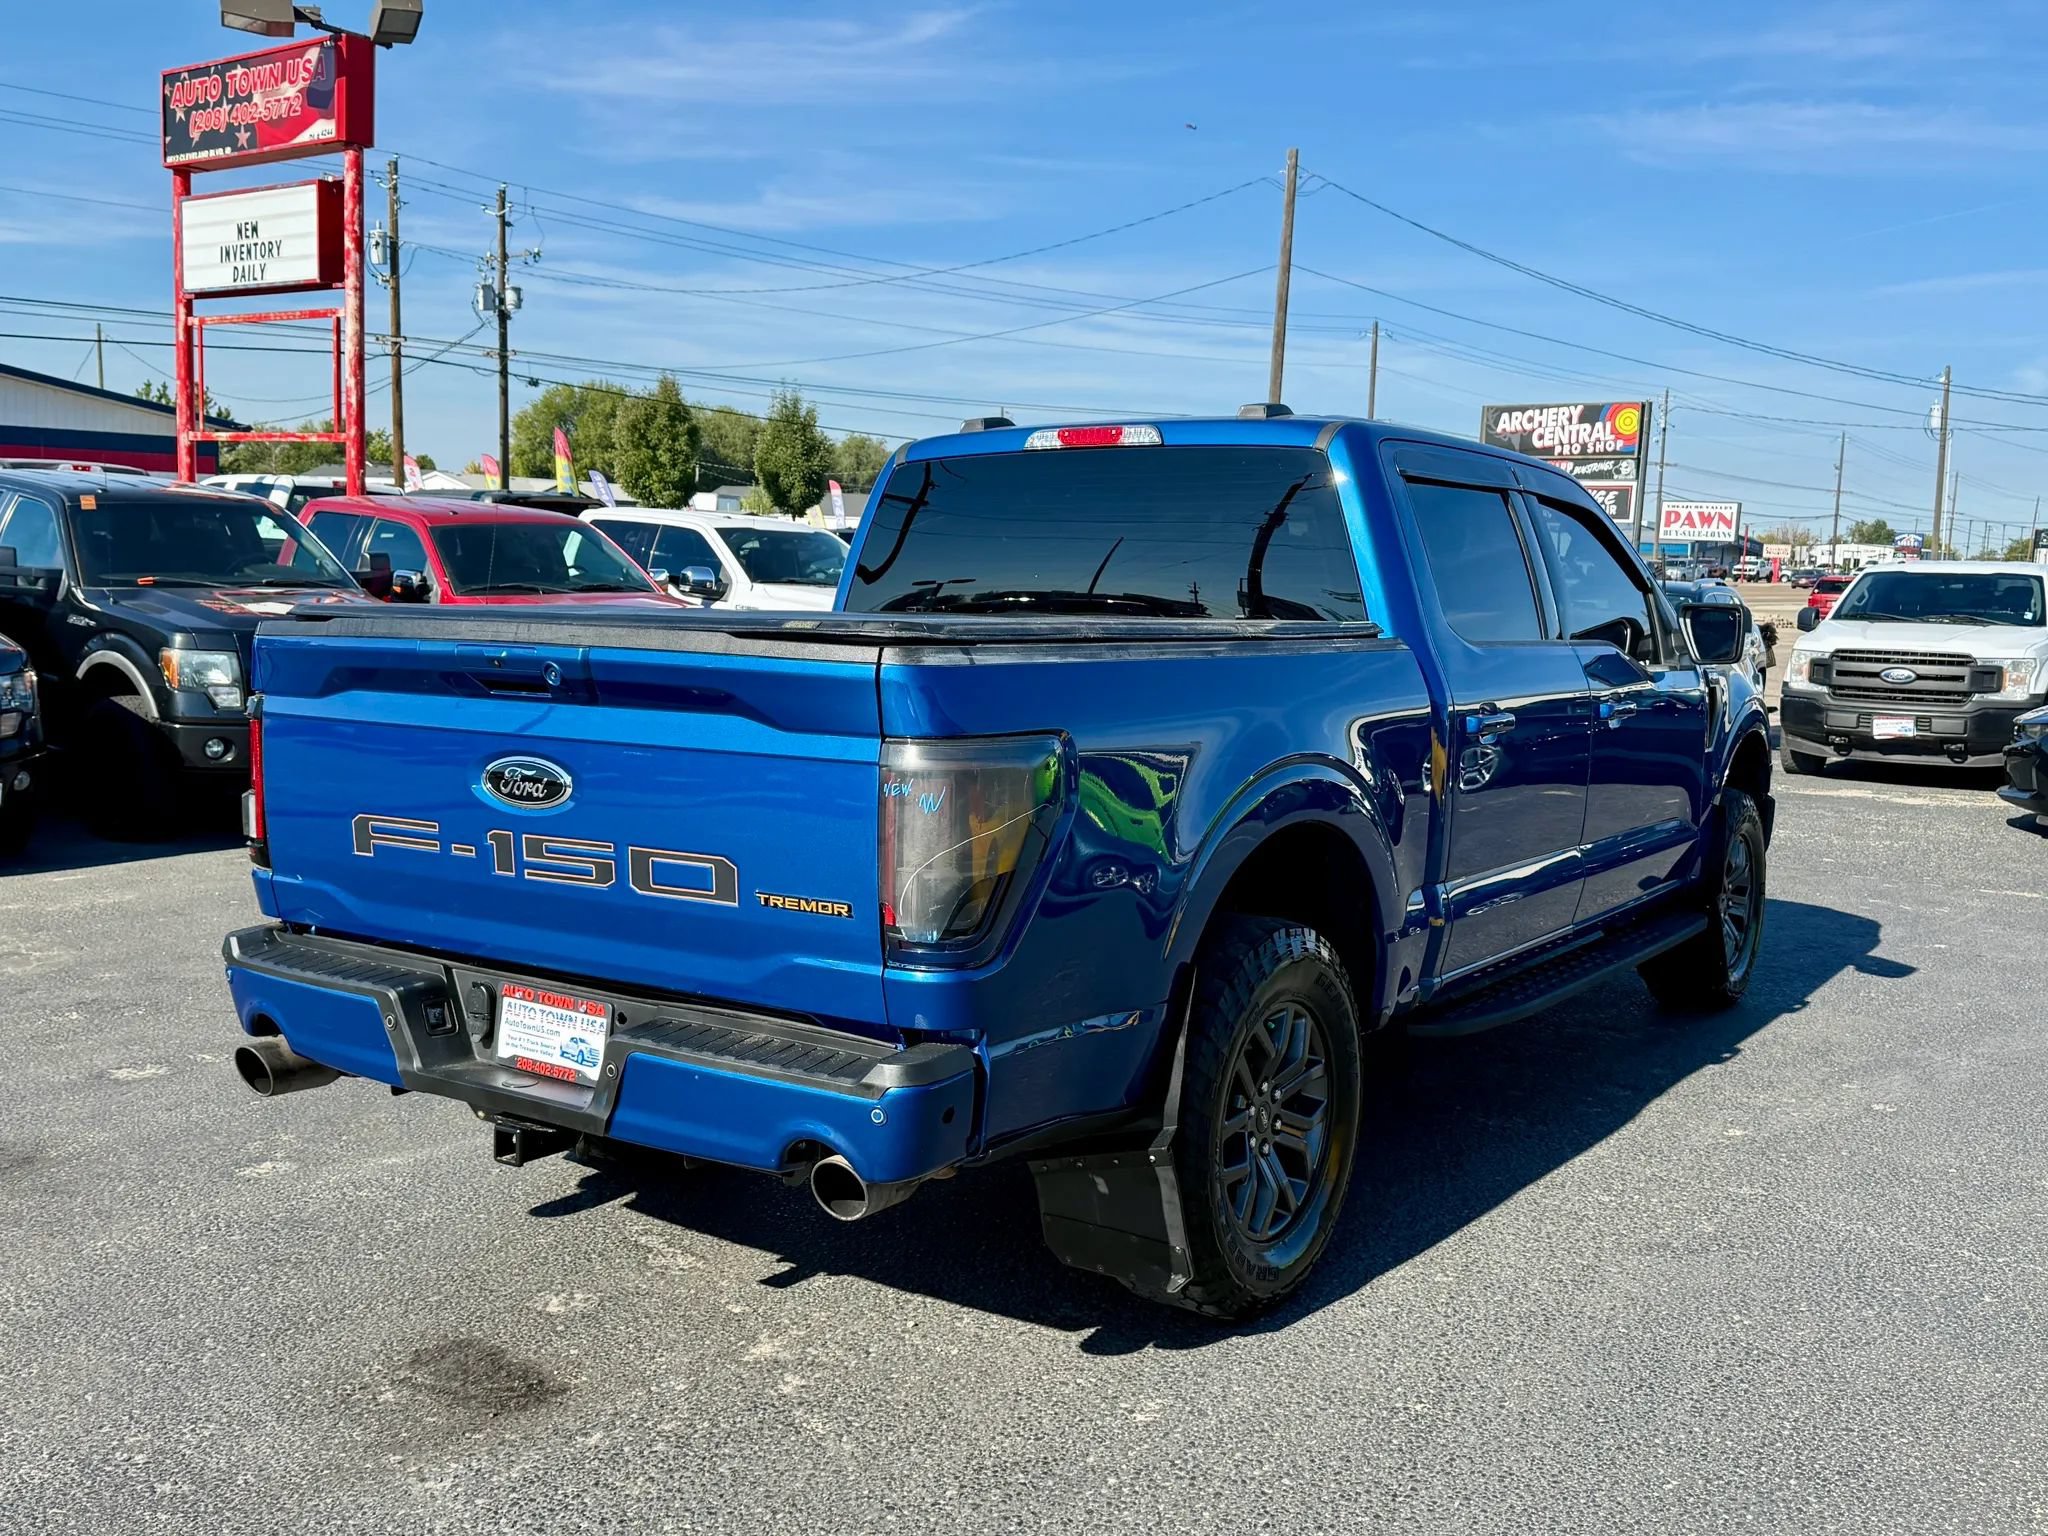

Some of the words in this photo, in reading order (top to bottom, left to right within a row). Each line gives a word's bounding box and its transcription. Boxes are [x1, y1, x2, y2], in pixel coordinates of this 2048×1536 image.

[170, 73, 222, 109] AUTO
[226, 63, 283, 97] TOWN
[286, 53, 326, 86] USA
[188, 107, 228, 138] (208)
[230, 92, 302, 125] 402-5772
[236, 220, 259, 241] NEW
[220, 240, 282, 264] INVENTORY
[233, 263, 267, 283] DAILY
[1496, 404, 1584, 435] ARCHERY
[1531, 421, 1616, 449] CENTRAL
[1554, 444, 1582, 456] PRO
[1587, 439, 1624, 454] SHOP
[1664, 510, 1733, 530] PAWN
[499, 766, 548, 800] Ford
[352, 814, 739, 907] F-150
[755, 891, 854, 918] TREMOR
[502, 983, 535, 1002] AUTO
[537, 991, 574, 1010] TOWN
[577, 999, 606, 1017] USA
[504, 1017, 561, 1037] AutoTownUS.com
